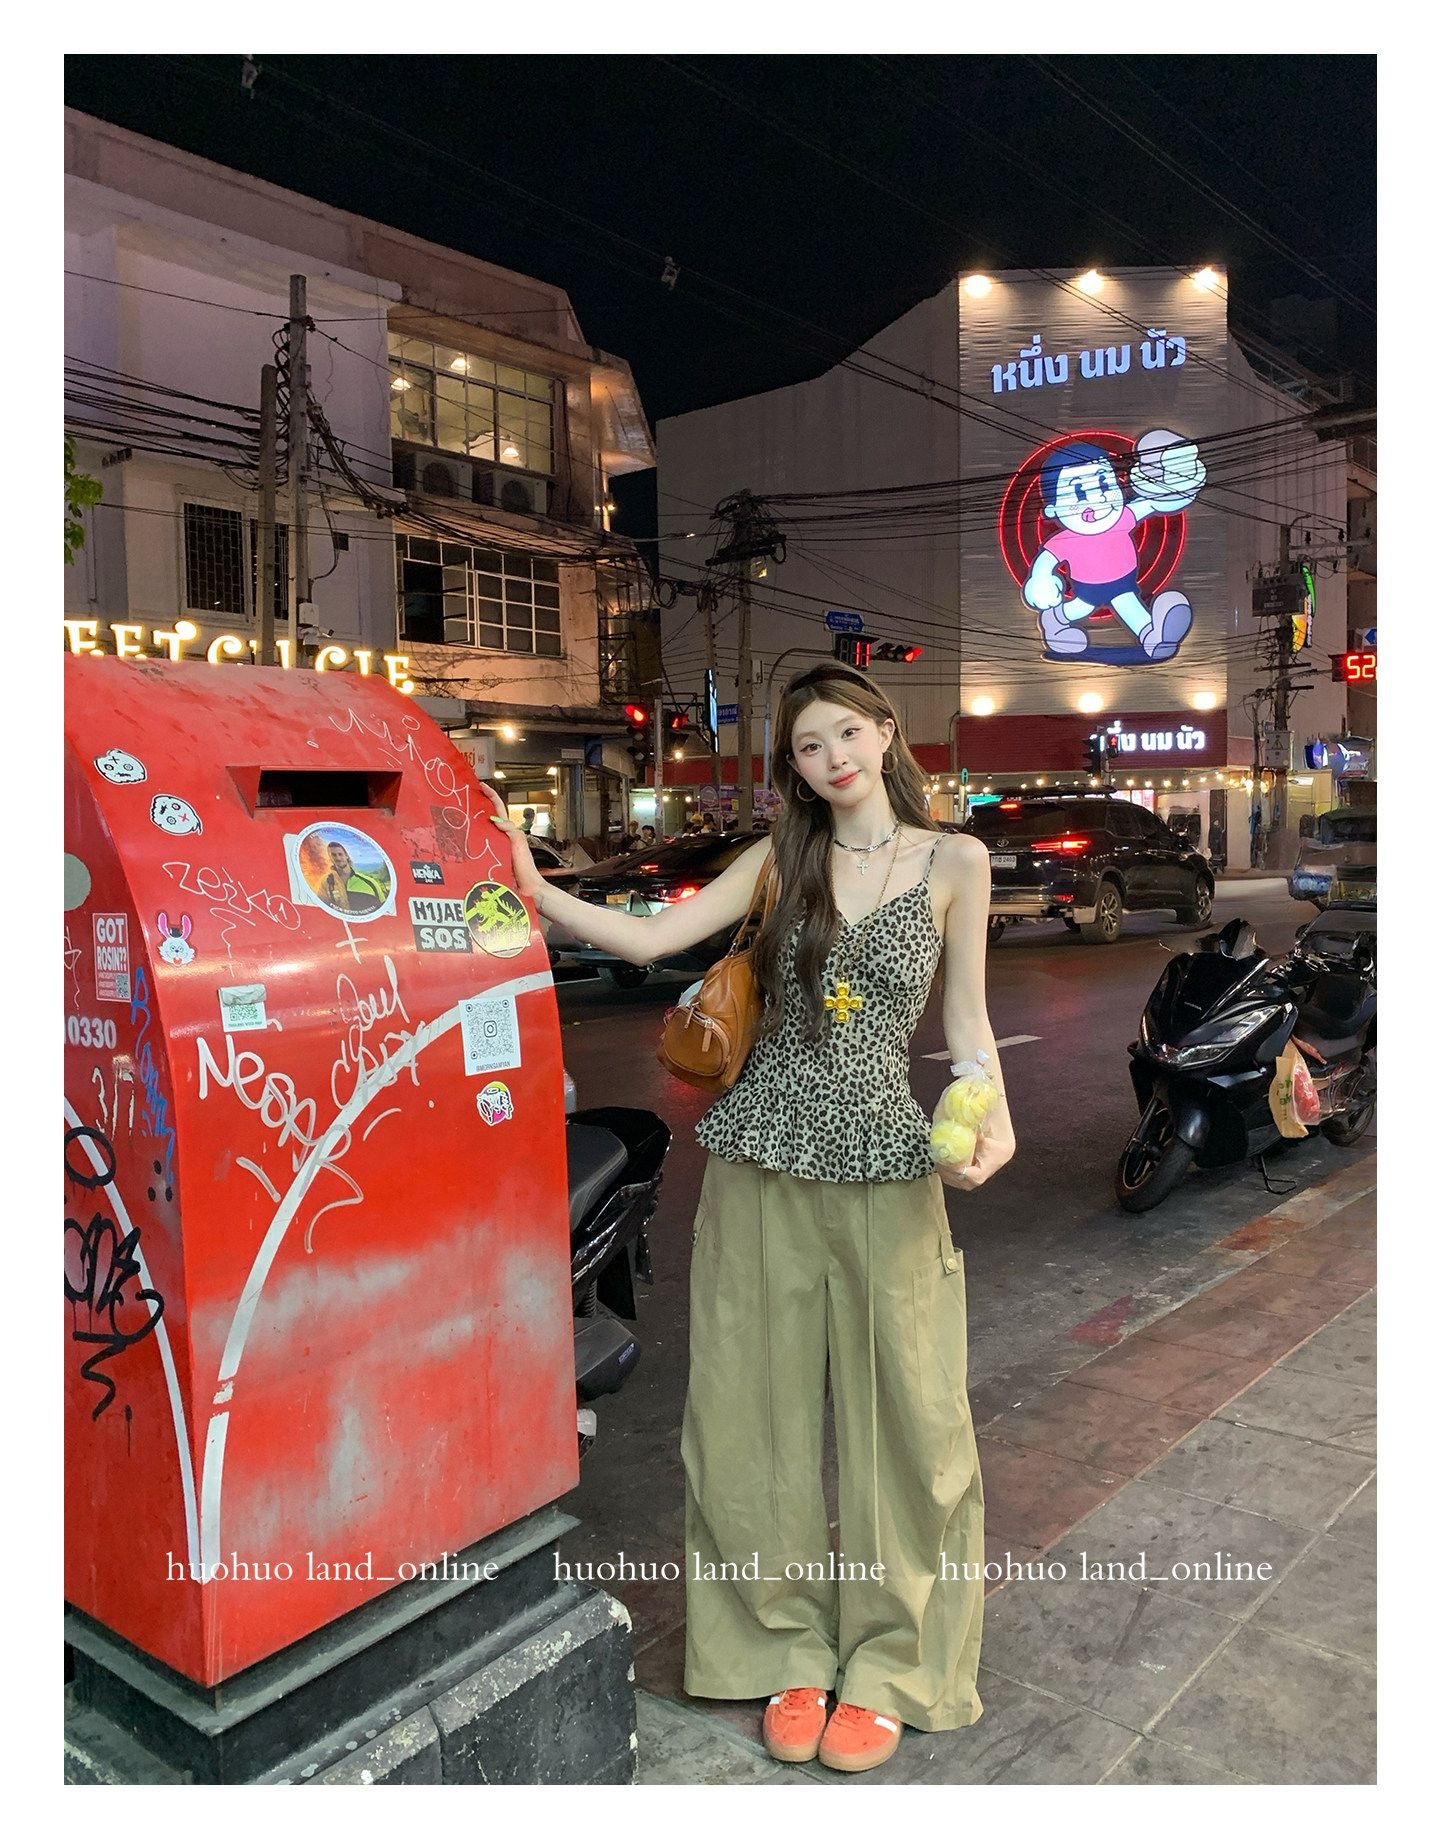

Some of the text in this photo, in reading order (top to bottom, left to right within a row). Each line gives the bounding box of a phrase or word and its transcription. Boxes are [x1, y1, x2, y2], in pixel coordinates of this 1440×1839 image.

[991, 334, 1069, 394] หนึ่ง
[1079, 344, 1131, 379] นม
[1140, 732, 1173, 751] นม
[96, 917, 124, 944] GOT
[420, 927, 467, 951] SOS
[96, 946, 127, 972] ROSIN??
